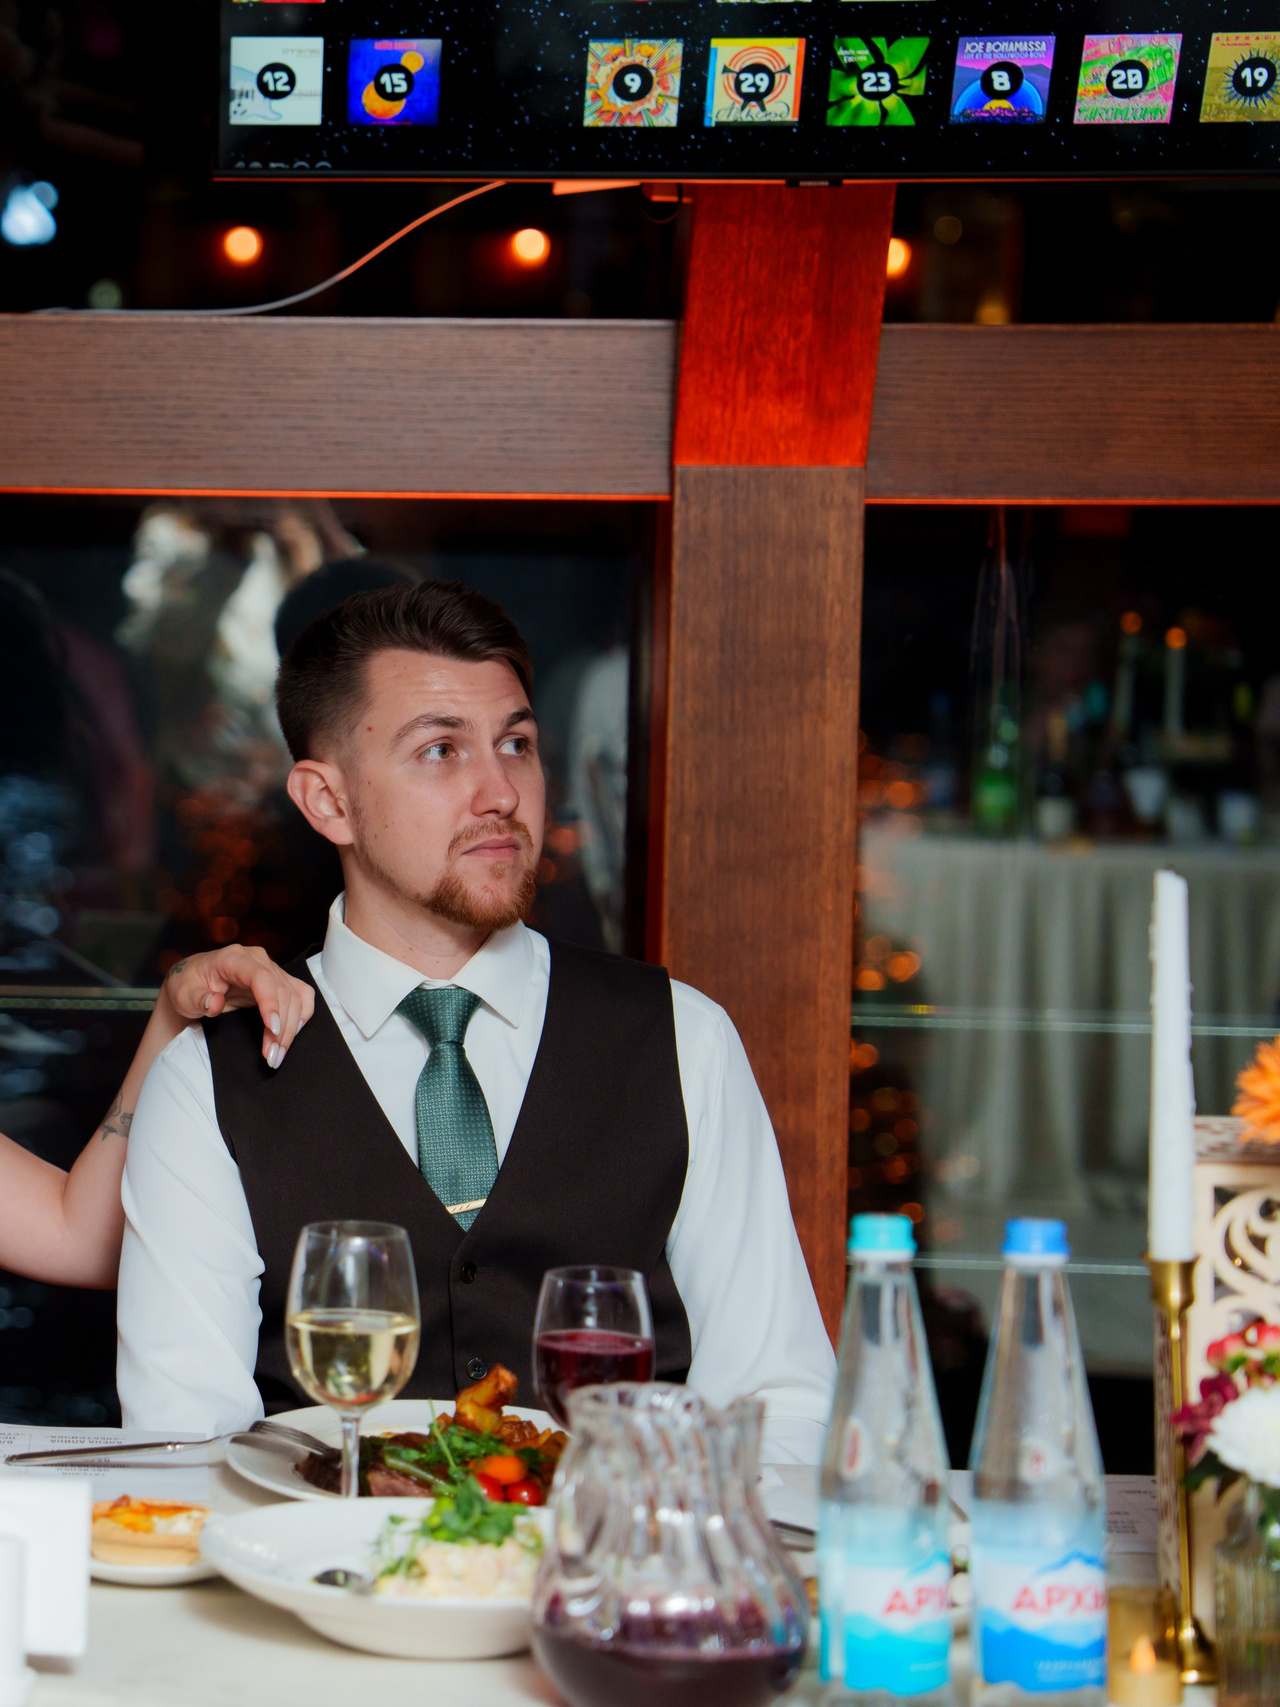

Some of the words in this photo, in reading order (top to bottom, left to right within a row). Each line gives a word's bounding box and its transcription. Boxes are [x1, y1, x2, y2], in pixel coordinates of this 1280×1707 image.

[262, 71, 291, 92] 12
[379, 72, 408, 93] 15
[623, 72, 642, 93] 9
[738, 73, 770, 93] 29
[861, 71, 892, 92] 23
[991, 71, 1011, 91] 8
[1240, 67, 1269, 88] 19
